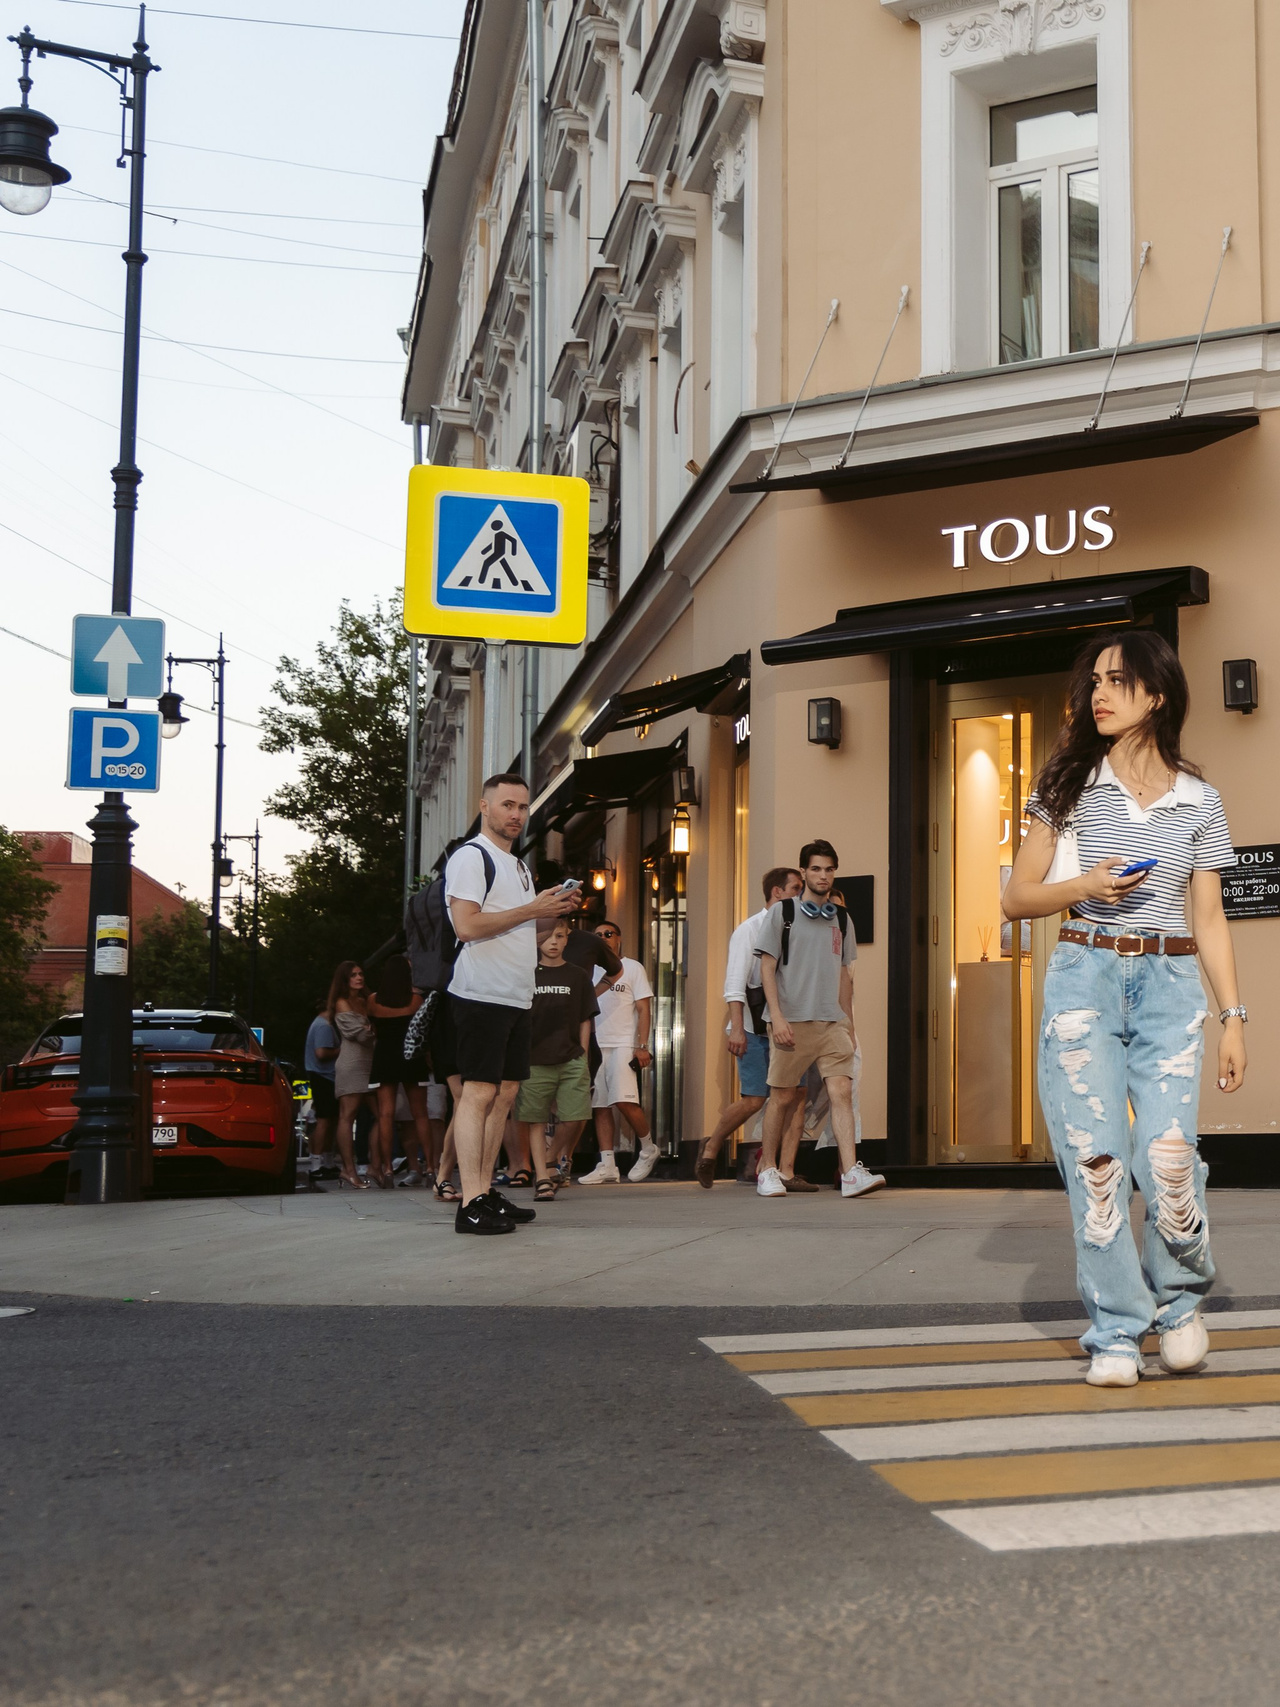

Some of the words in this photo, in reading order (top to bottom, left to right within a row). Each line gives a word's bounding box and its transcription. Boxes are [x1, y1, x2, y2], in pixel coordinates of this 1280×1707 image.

[941, 505, 1115, 568] TOUS
[90, 717, 140, 779] P
[118, 766, 127, 774] 15
[130, 766, 144, 775] 20
[1245, 877, 1267, 886] работы
[1222, 886, 1244, 897] 0:00
[1252, 883, 1280, 895] 22:00
